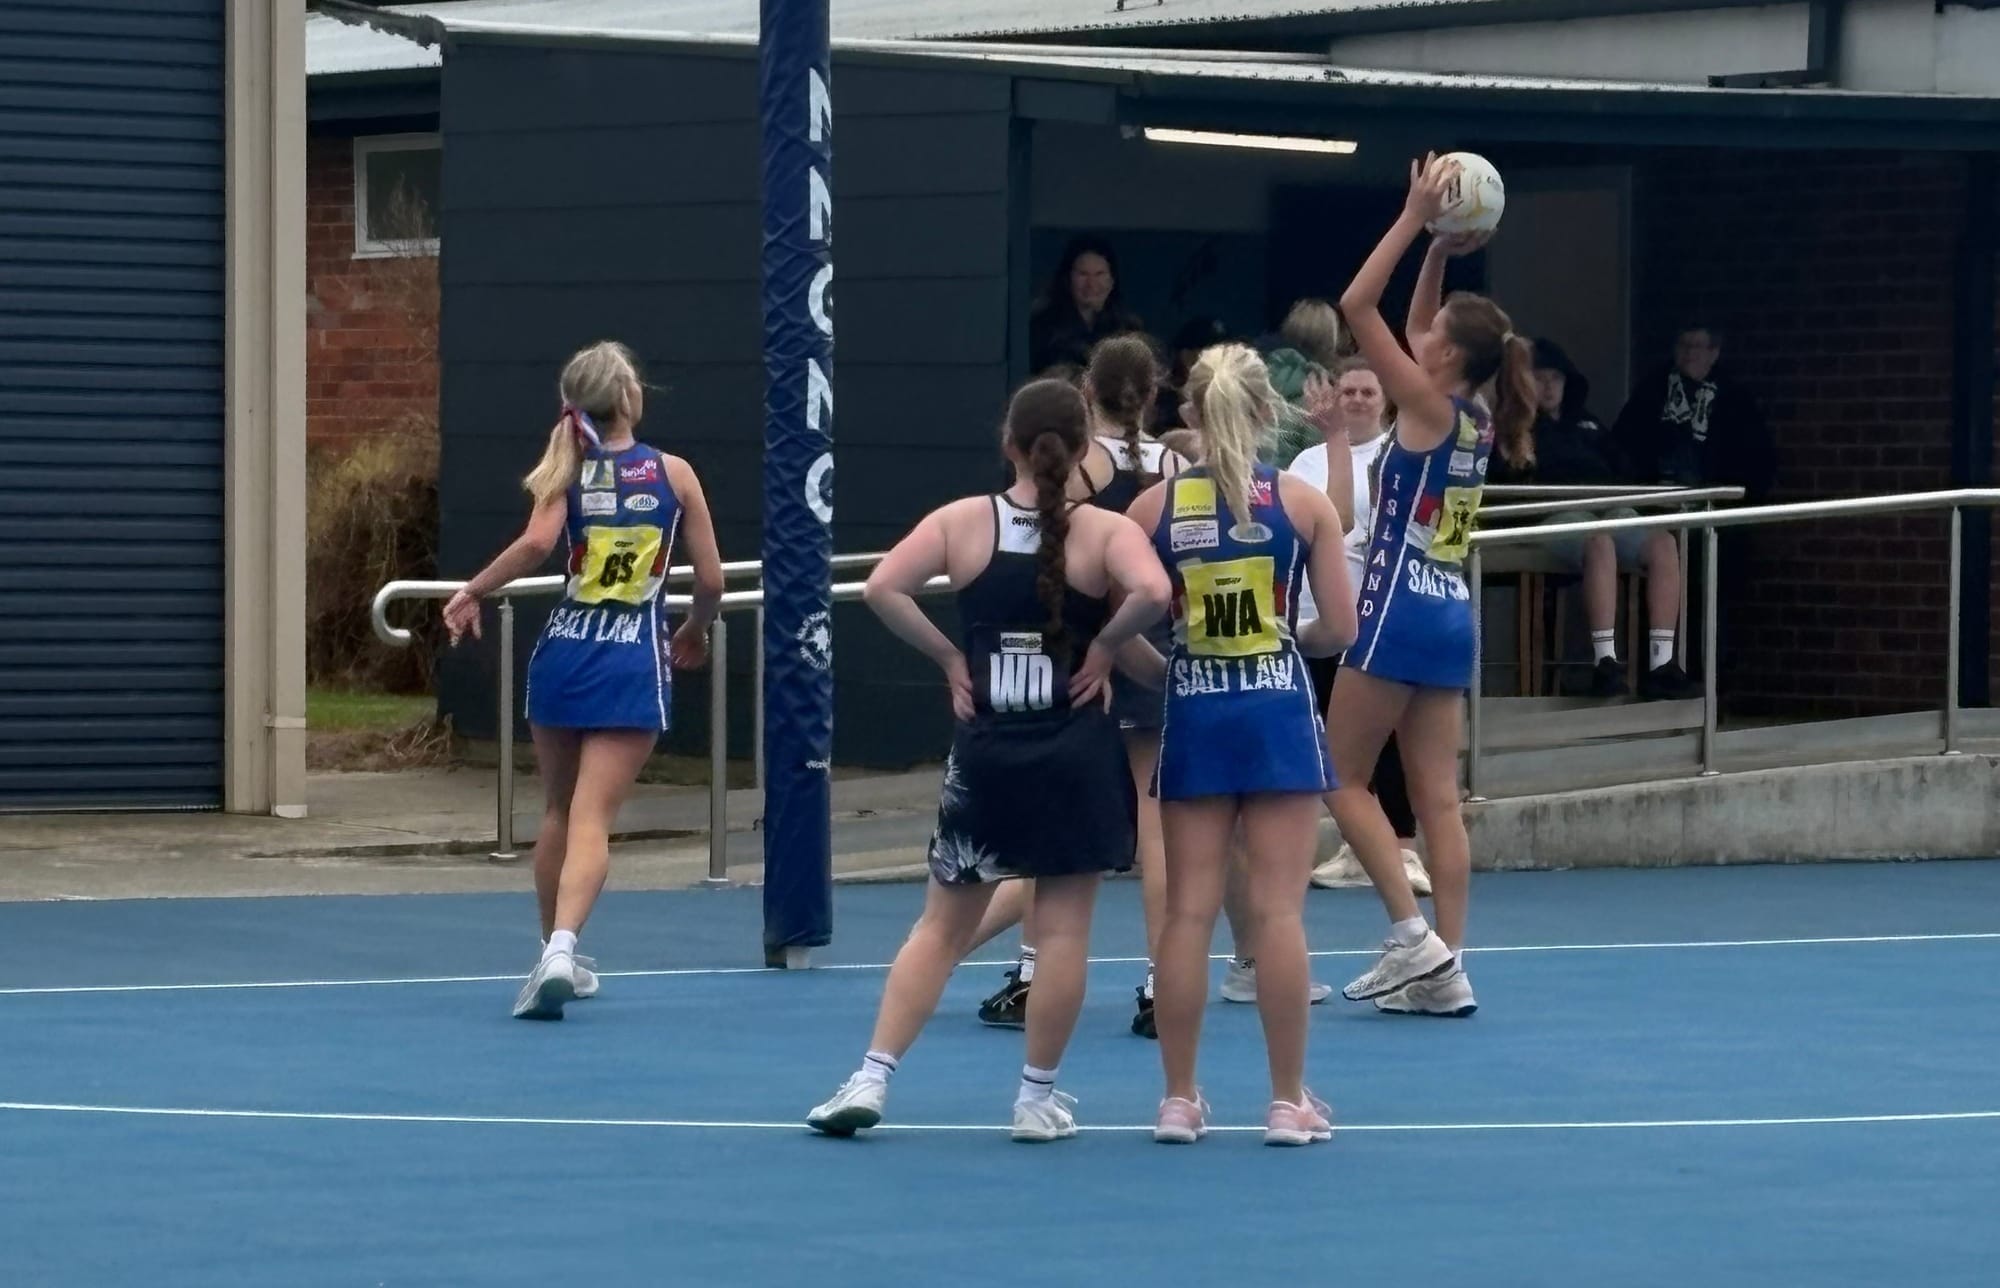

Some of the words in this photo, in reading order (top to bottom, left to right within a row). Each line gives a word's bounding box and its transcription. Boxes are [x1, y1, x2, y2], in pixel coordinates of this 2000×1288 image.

[1361, 473, 1401, 616] ISLAND
[599, 552, 638, 588] GS
[1203, 588, 1262, 638] WA
[990, 652, 1053, 712] WD
[1174, 658, 1230, 696] SALT
